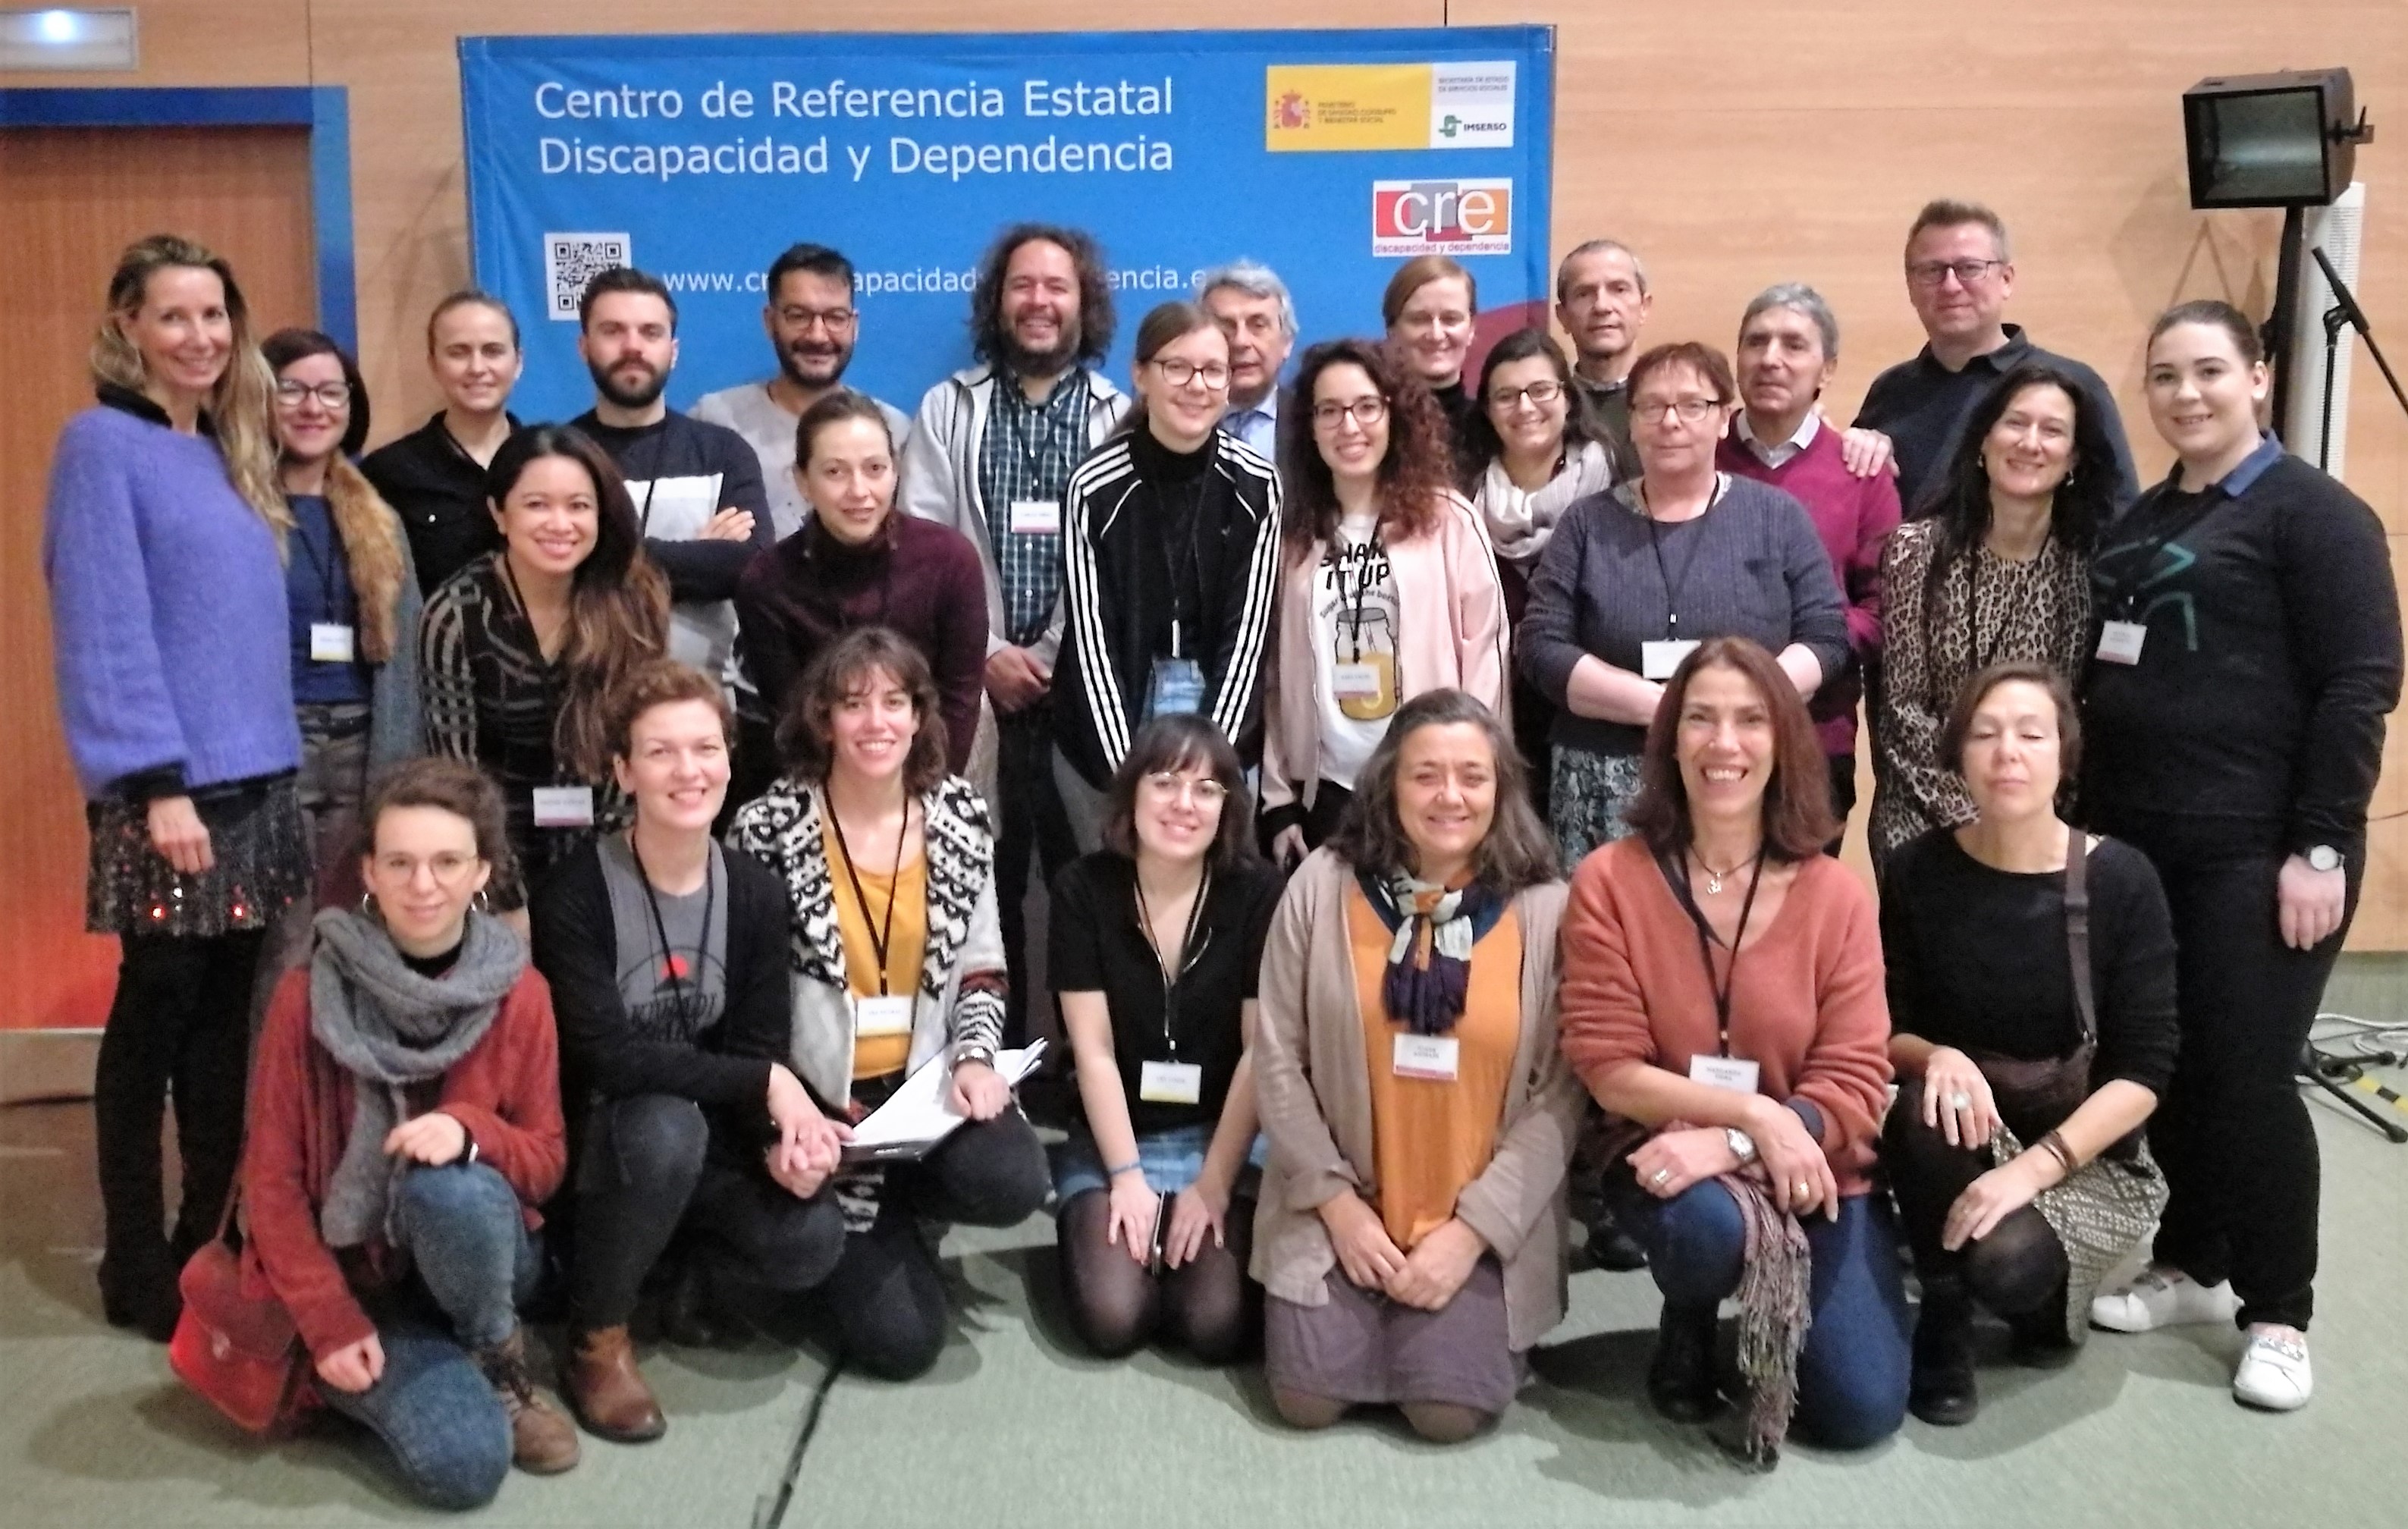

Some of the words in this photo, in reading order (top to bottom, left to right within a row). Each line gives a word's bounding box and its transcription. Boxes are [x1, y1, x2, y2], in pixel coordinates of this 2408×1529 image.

[535, 82, 683, 119] Centro
[701, 80, 754, 118] de
[773, 80, 1004, 118] Referencia
[1025, 77, 1173, 117] Estatal
[1464, 122, 1507, 132] IMSERSO
[540, 136, 828, 181] Discapacidad
[847, 146, 871, 182] y
[890, 134, 1173, 182] Dependencia
[1394, 189, 1496, 235] cre
[1358, 562, 1389, 589] UP
